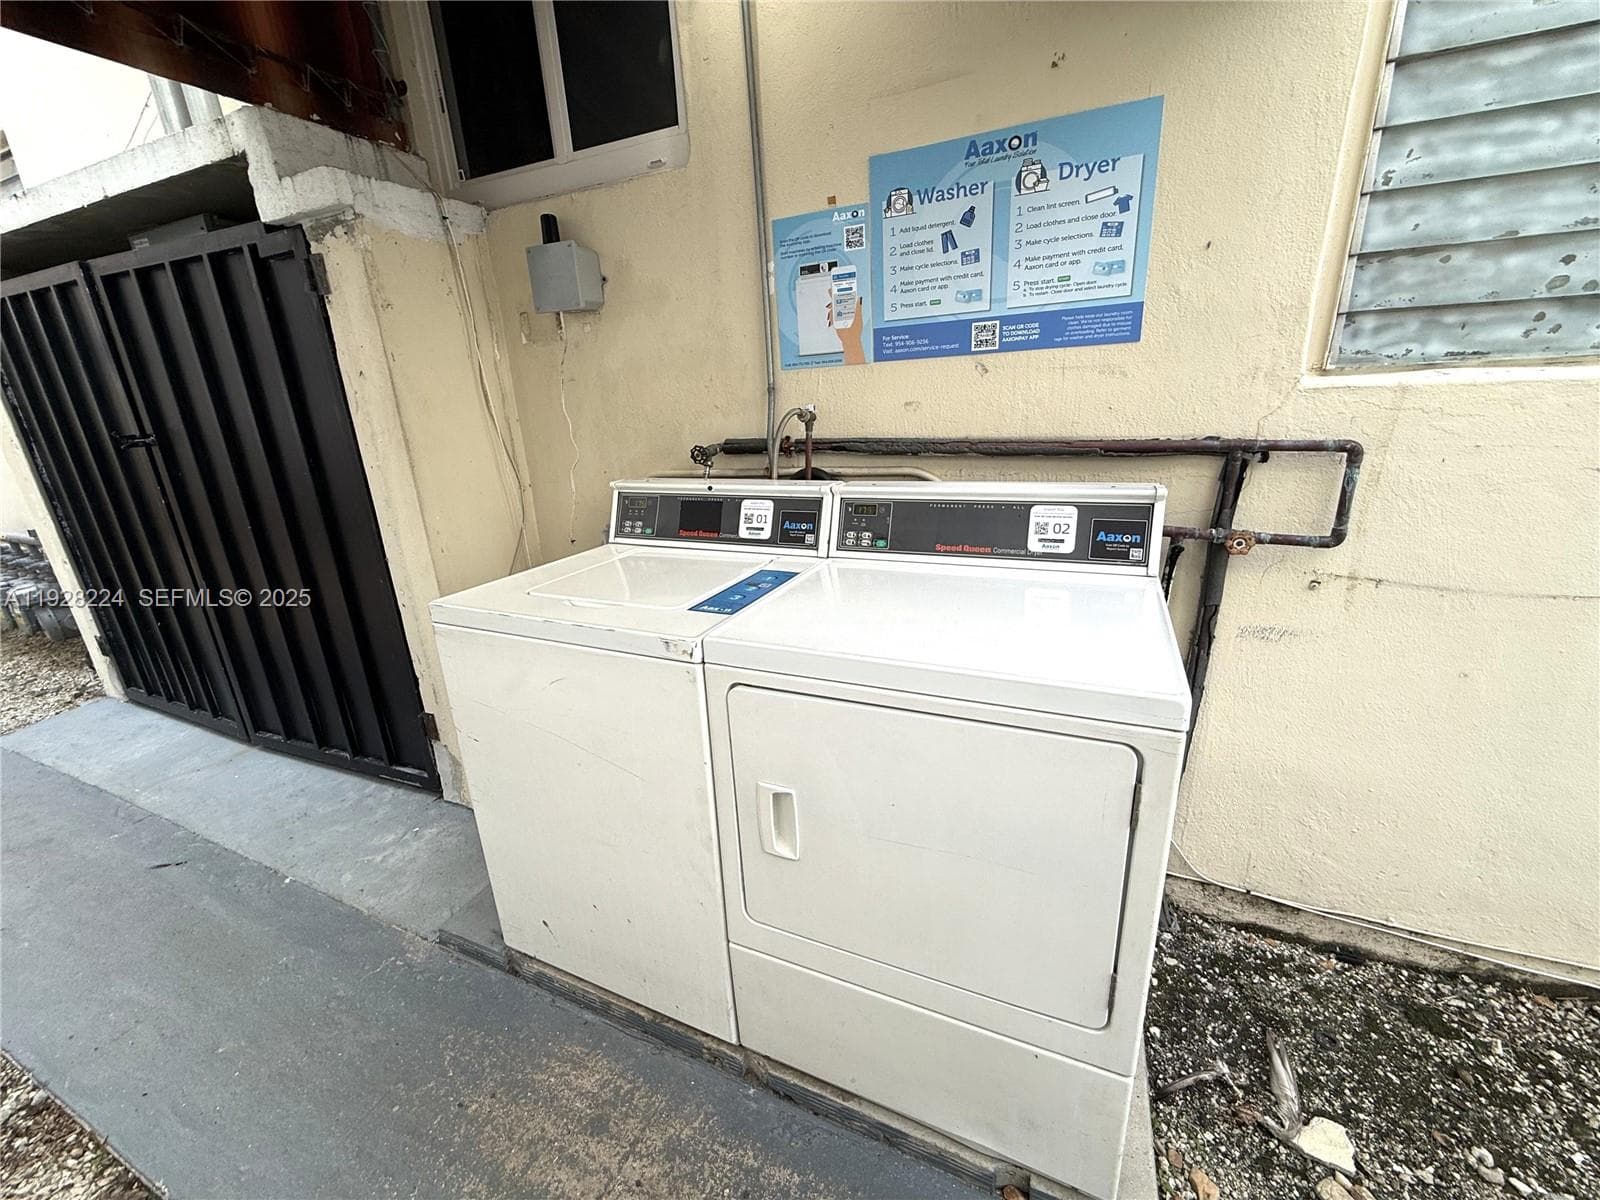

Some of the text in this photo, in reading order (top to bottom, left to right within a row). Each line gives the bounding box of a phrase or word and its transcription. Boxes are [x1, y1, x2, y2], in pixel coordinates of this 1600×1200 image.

[964, 131, 1038, 160] Aaxon
[1058, 156, 1120, 181] Dryer
[917, 181, 988, 205] Washer
[832, 209, 865, 222] Aaxon
[1017, 206, 1023, 216] 1
[890, 227, 896, 236] 1
[912, 224, 926, 232] liquid
[1015, 223, 1023, 233] 2
[1043, 218, 1066, 227] clothes
[1015, 240, 1022, 249] 3
[1043, 236, 1060, 245] cycle
[890, 247, 897, 256] 2
[1013, 260, 1021, 269] 4
[1042, 252, 1070, 261] payment
[890, 266, 897, 275] 3
[890, 285, 897, 294] 4
[915, 277, 939, 285] payment
[1012, 281, 1020, 290] 5
[891, 303, 897, 312] 5
[756, 514, 768, 524] 01
[784, 521, 813, 530] Aaxon
[1053, 523, 1071, 535] 02
[1096, 531, 1141, 543] Aaxon
[935, 544, 963, 553] Speed
[964, 545, 992, 553] Queen
[993, 547, 1026, 555] Commercial
